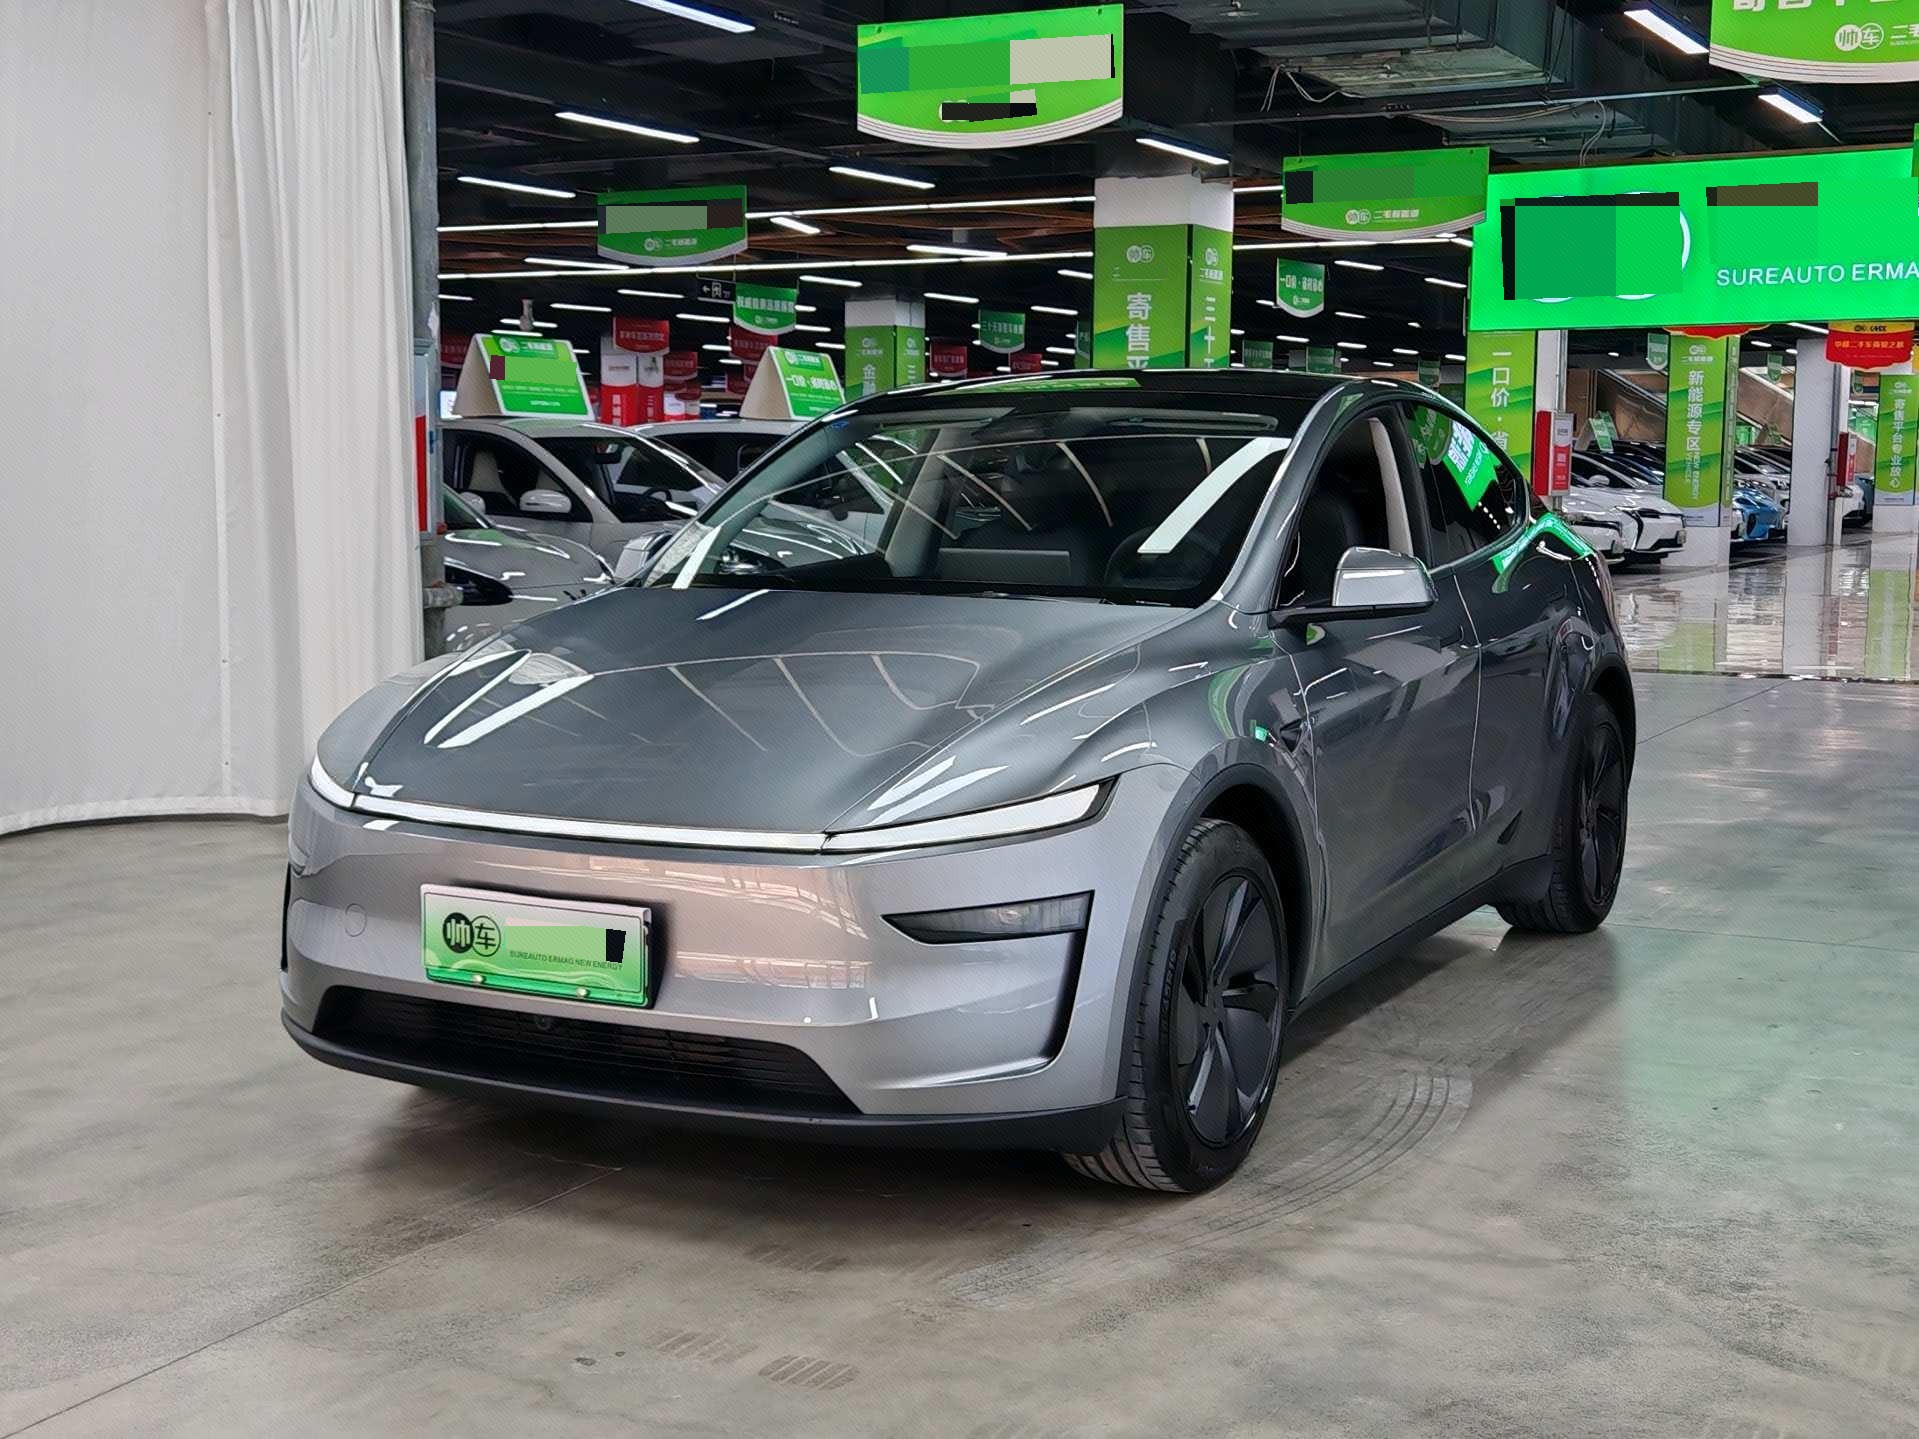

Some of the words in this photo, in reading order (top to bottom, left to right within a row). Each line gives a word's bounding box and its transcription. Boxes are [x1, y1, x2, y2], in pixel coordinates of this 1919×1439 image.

[1836, 23, 1884, 51] 帅车
[1717, 265, 1845, 286] SUREAUTO
[1686, 370, 1704, 450] 新能源专区
[444, 914, 500, 955] 帅车
[575, 958, 591, 968] NEW
